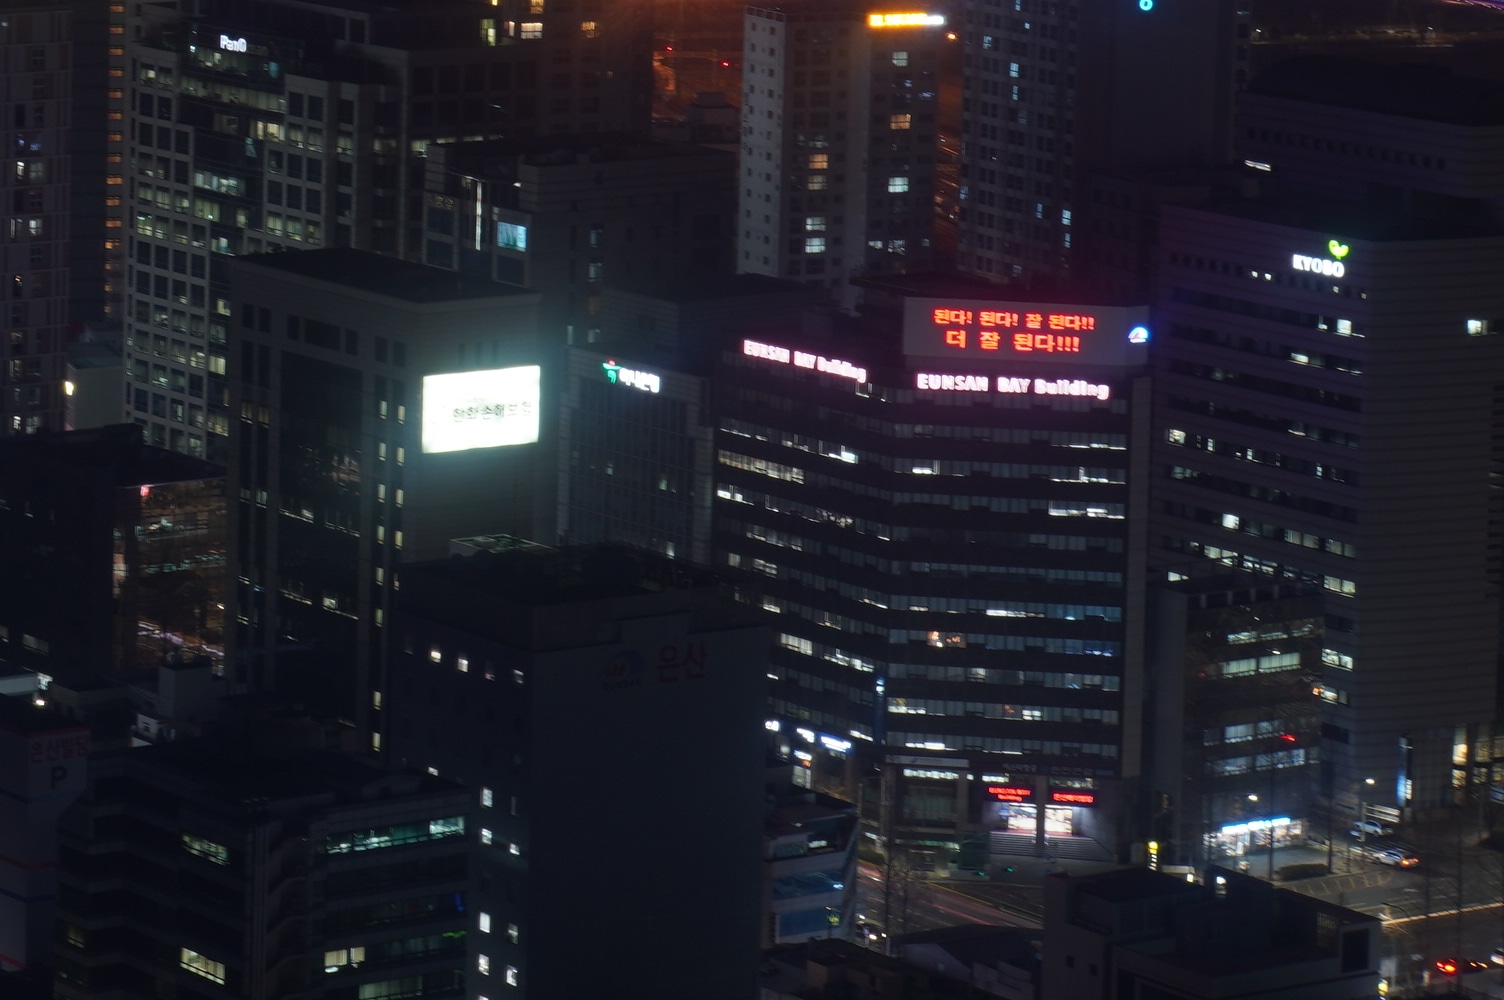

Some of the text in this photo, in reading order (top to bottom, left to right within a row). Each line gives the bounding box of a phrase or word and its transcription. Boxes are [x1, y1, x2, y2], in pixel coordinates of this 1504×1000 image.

[1293, 253, 1345, 278] KYOBO
[933, 308, 1095, 331] 된다! 된다! 잘 된다!!
[946, 330, 1080, 353] 더 잘 된다!!!
[917, 373, 1110, 400] EUNSAN BAY Building
[657, 642, 708, 684] 은산
[50, 766, 67, 790] P
